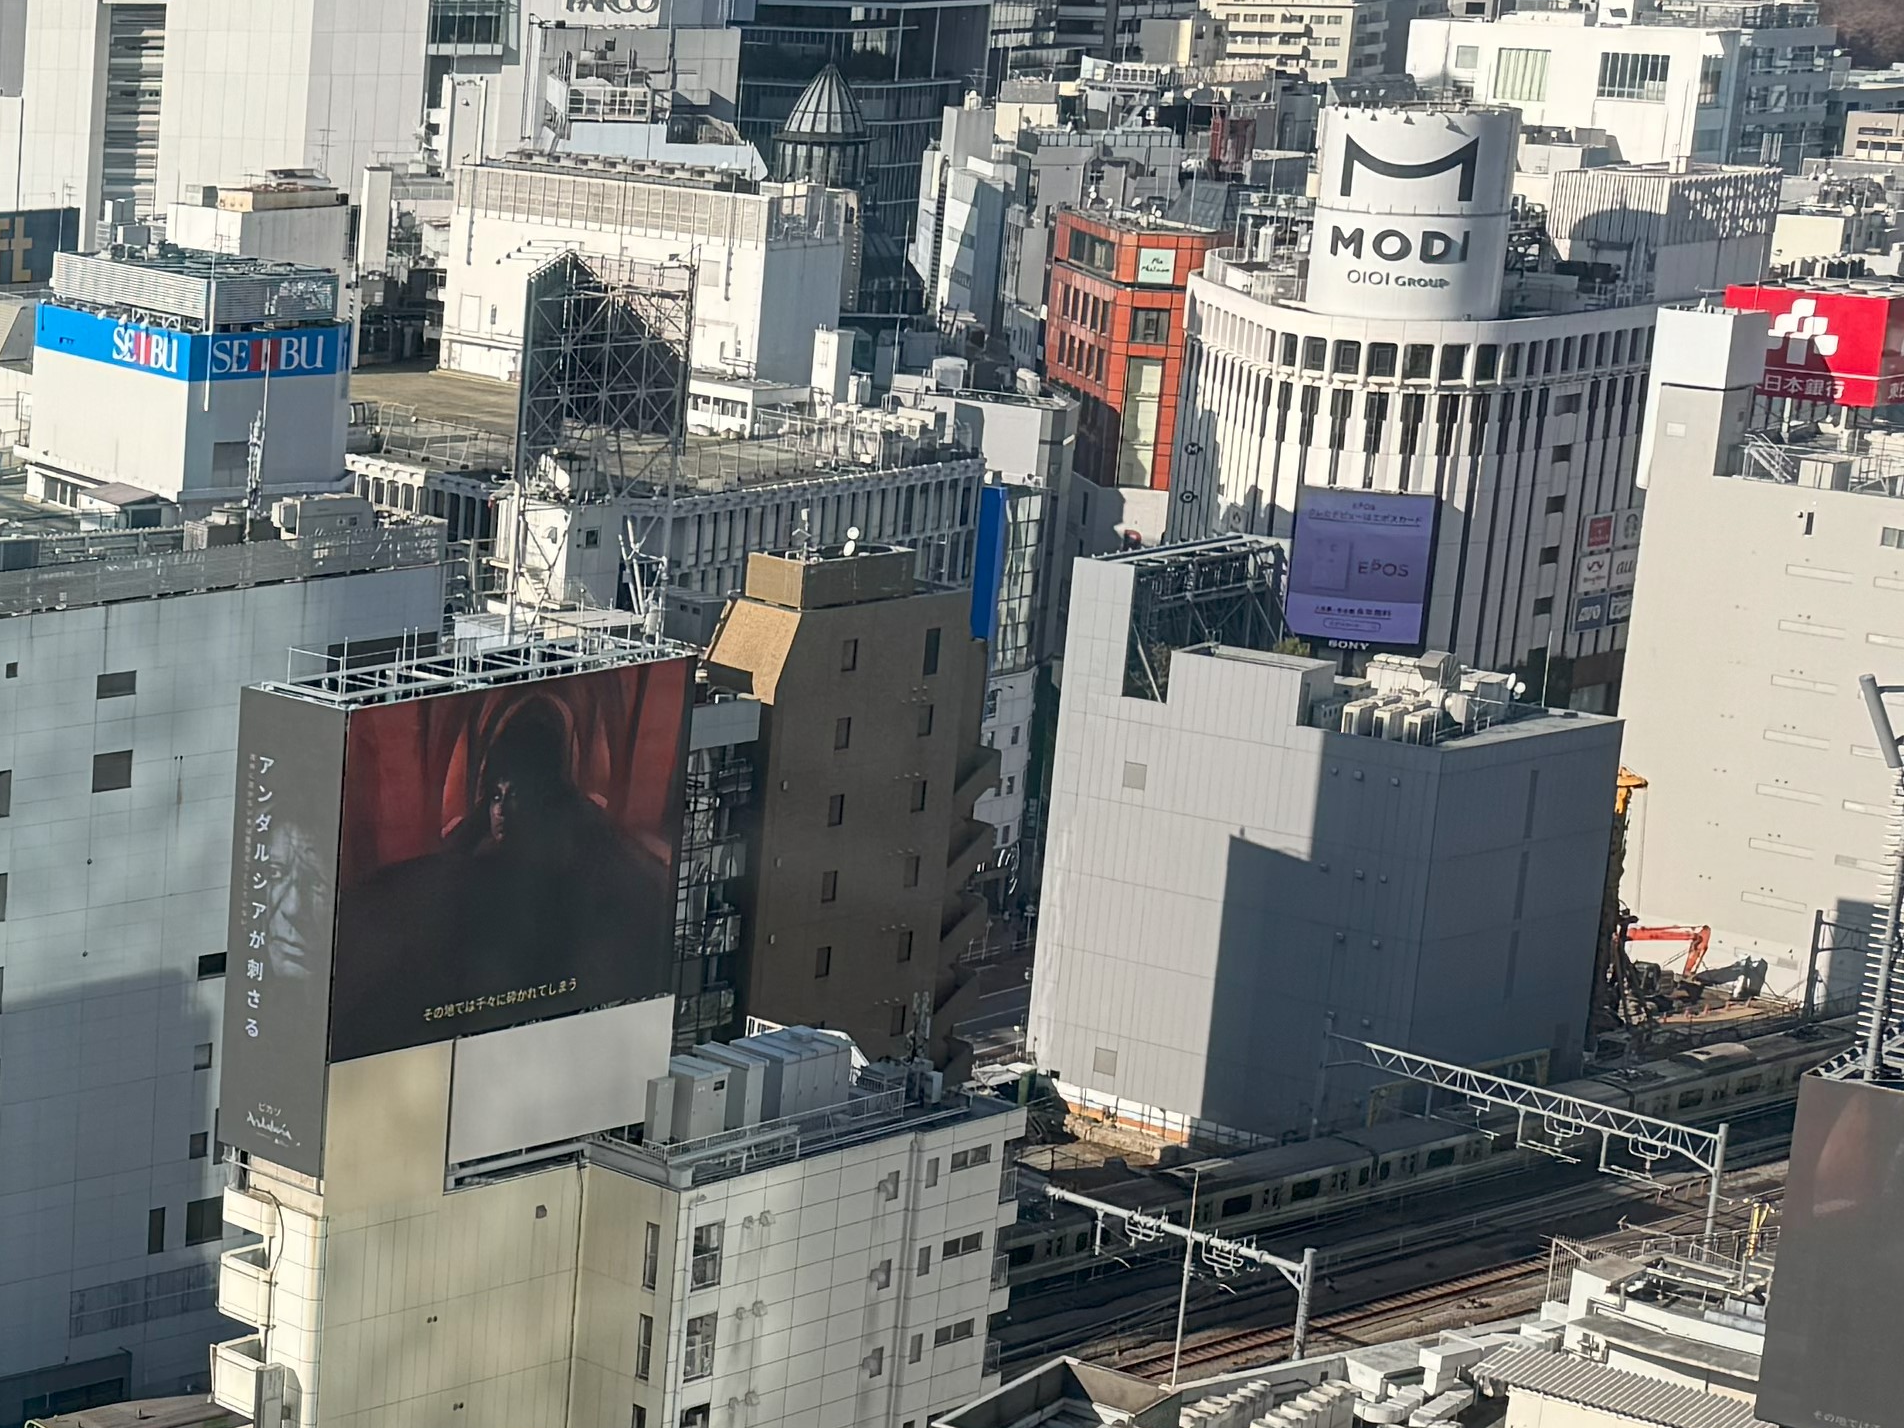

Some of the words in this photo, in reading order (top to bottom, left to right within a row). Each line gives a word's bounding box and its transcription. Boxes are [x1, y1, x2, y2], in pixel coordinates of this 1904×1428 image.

[1329, 225, 1470, 264] MODI
[1394, 276, 1449, 290] GROUP
[1756, 374, 1845, 399] 日本銀行
[1329, 639, 1370, 650] SONY
[244, 755, 275, 1039] アンダルシアが刺さる
